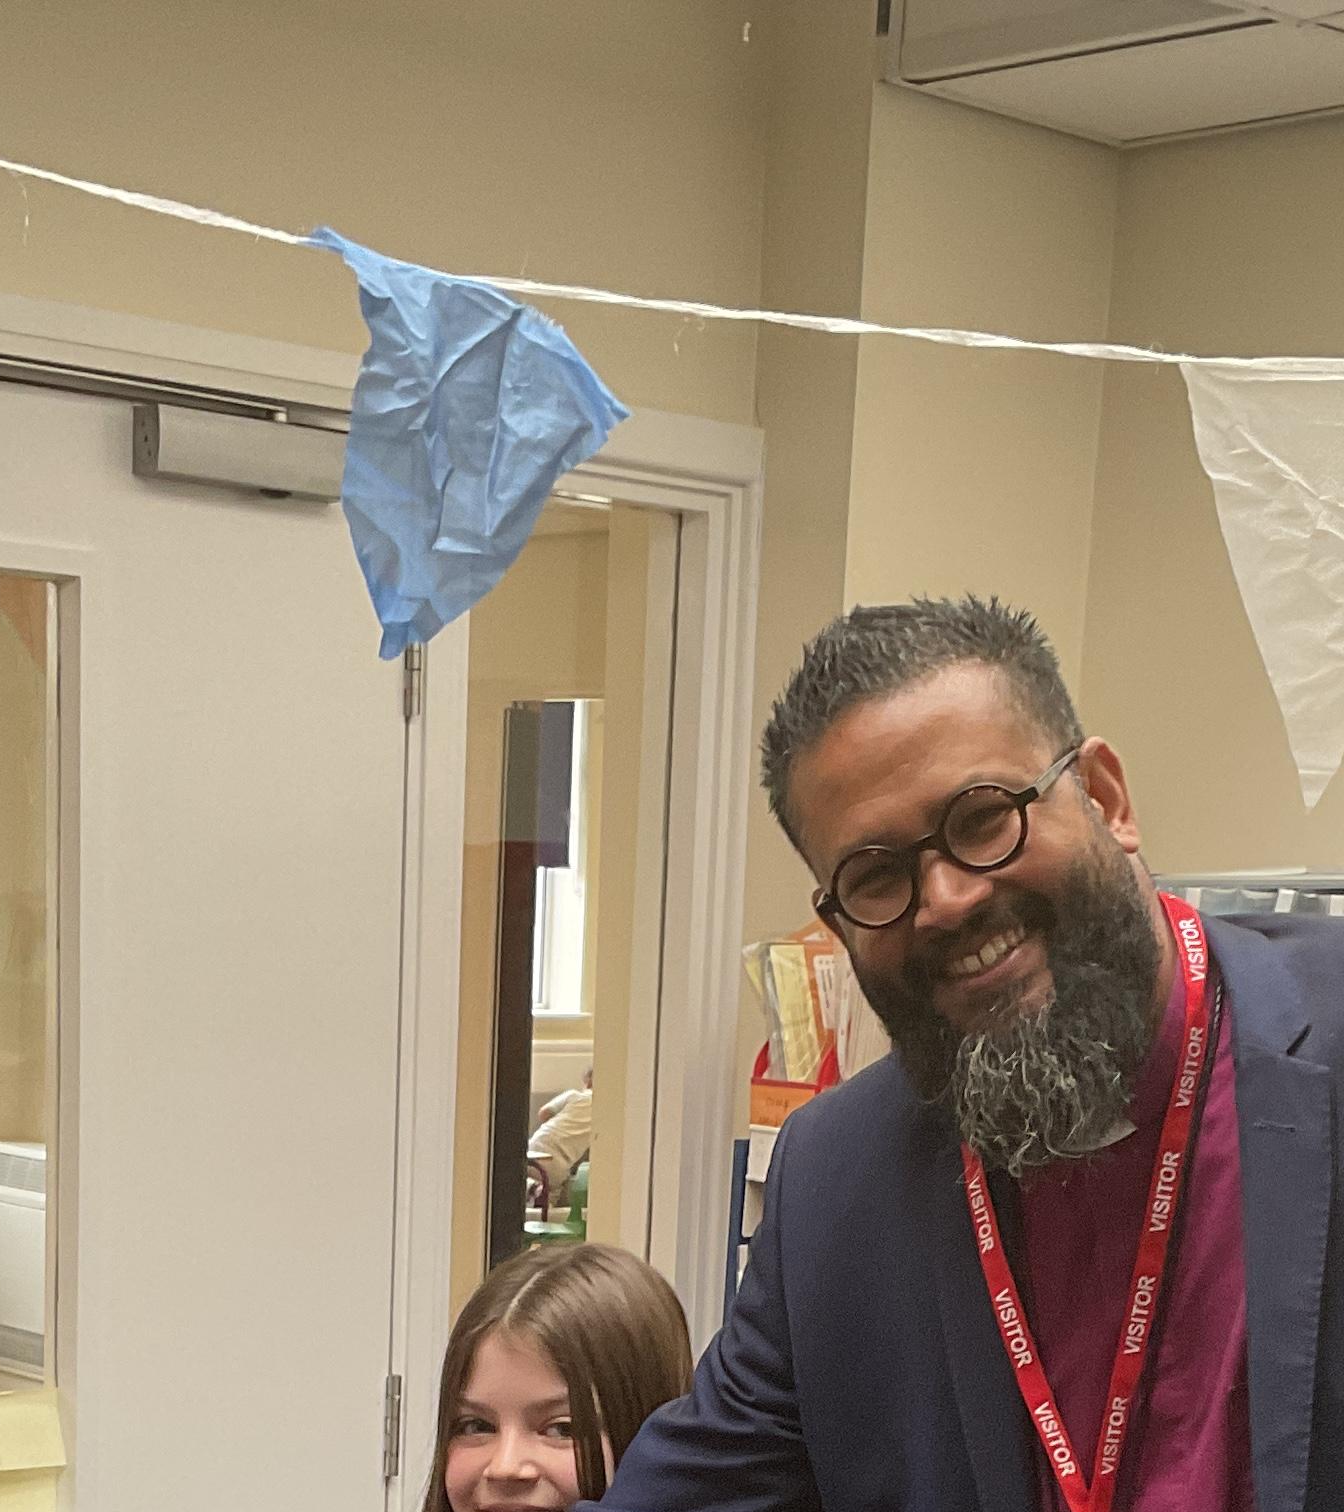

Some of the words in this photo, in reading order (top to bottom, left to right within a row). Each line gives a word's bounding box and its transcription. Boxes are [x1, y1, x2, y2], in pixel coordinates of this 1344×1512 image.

[1178, 918, 1206, 982] VISITOR
[1175, 1026, 1204, 1109] VISITOR
[966, 1176, 993, 1254] VISITOR
[1149, 1151, 1182, 1234] VISITOR
[994, 1287, 1032, 1369] VISITOR
[1123, 1274, 1156, 1356] VISITOR
[1033, 1401, 1074, 1477] VISITOR
[1100, 1396, 1128, 1476] VISITOR
